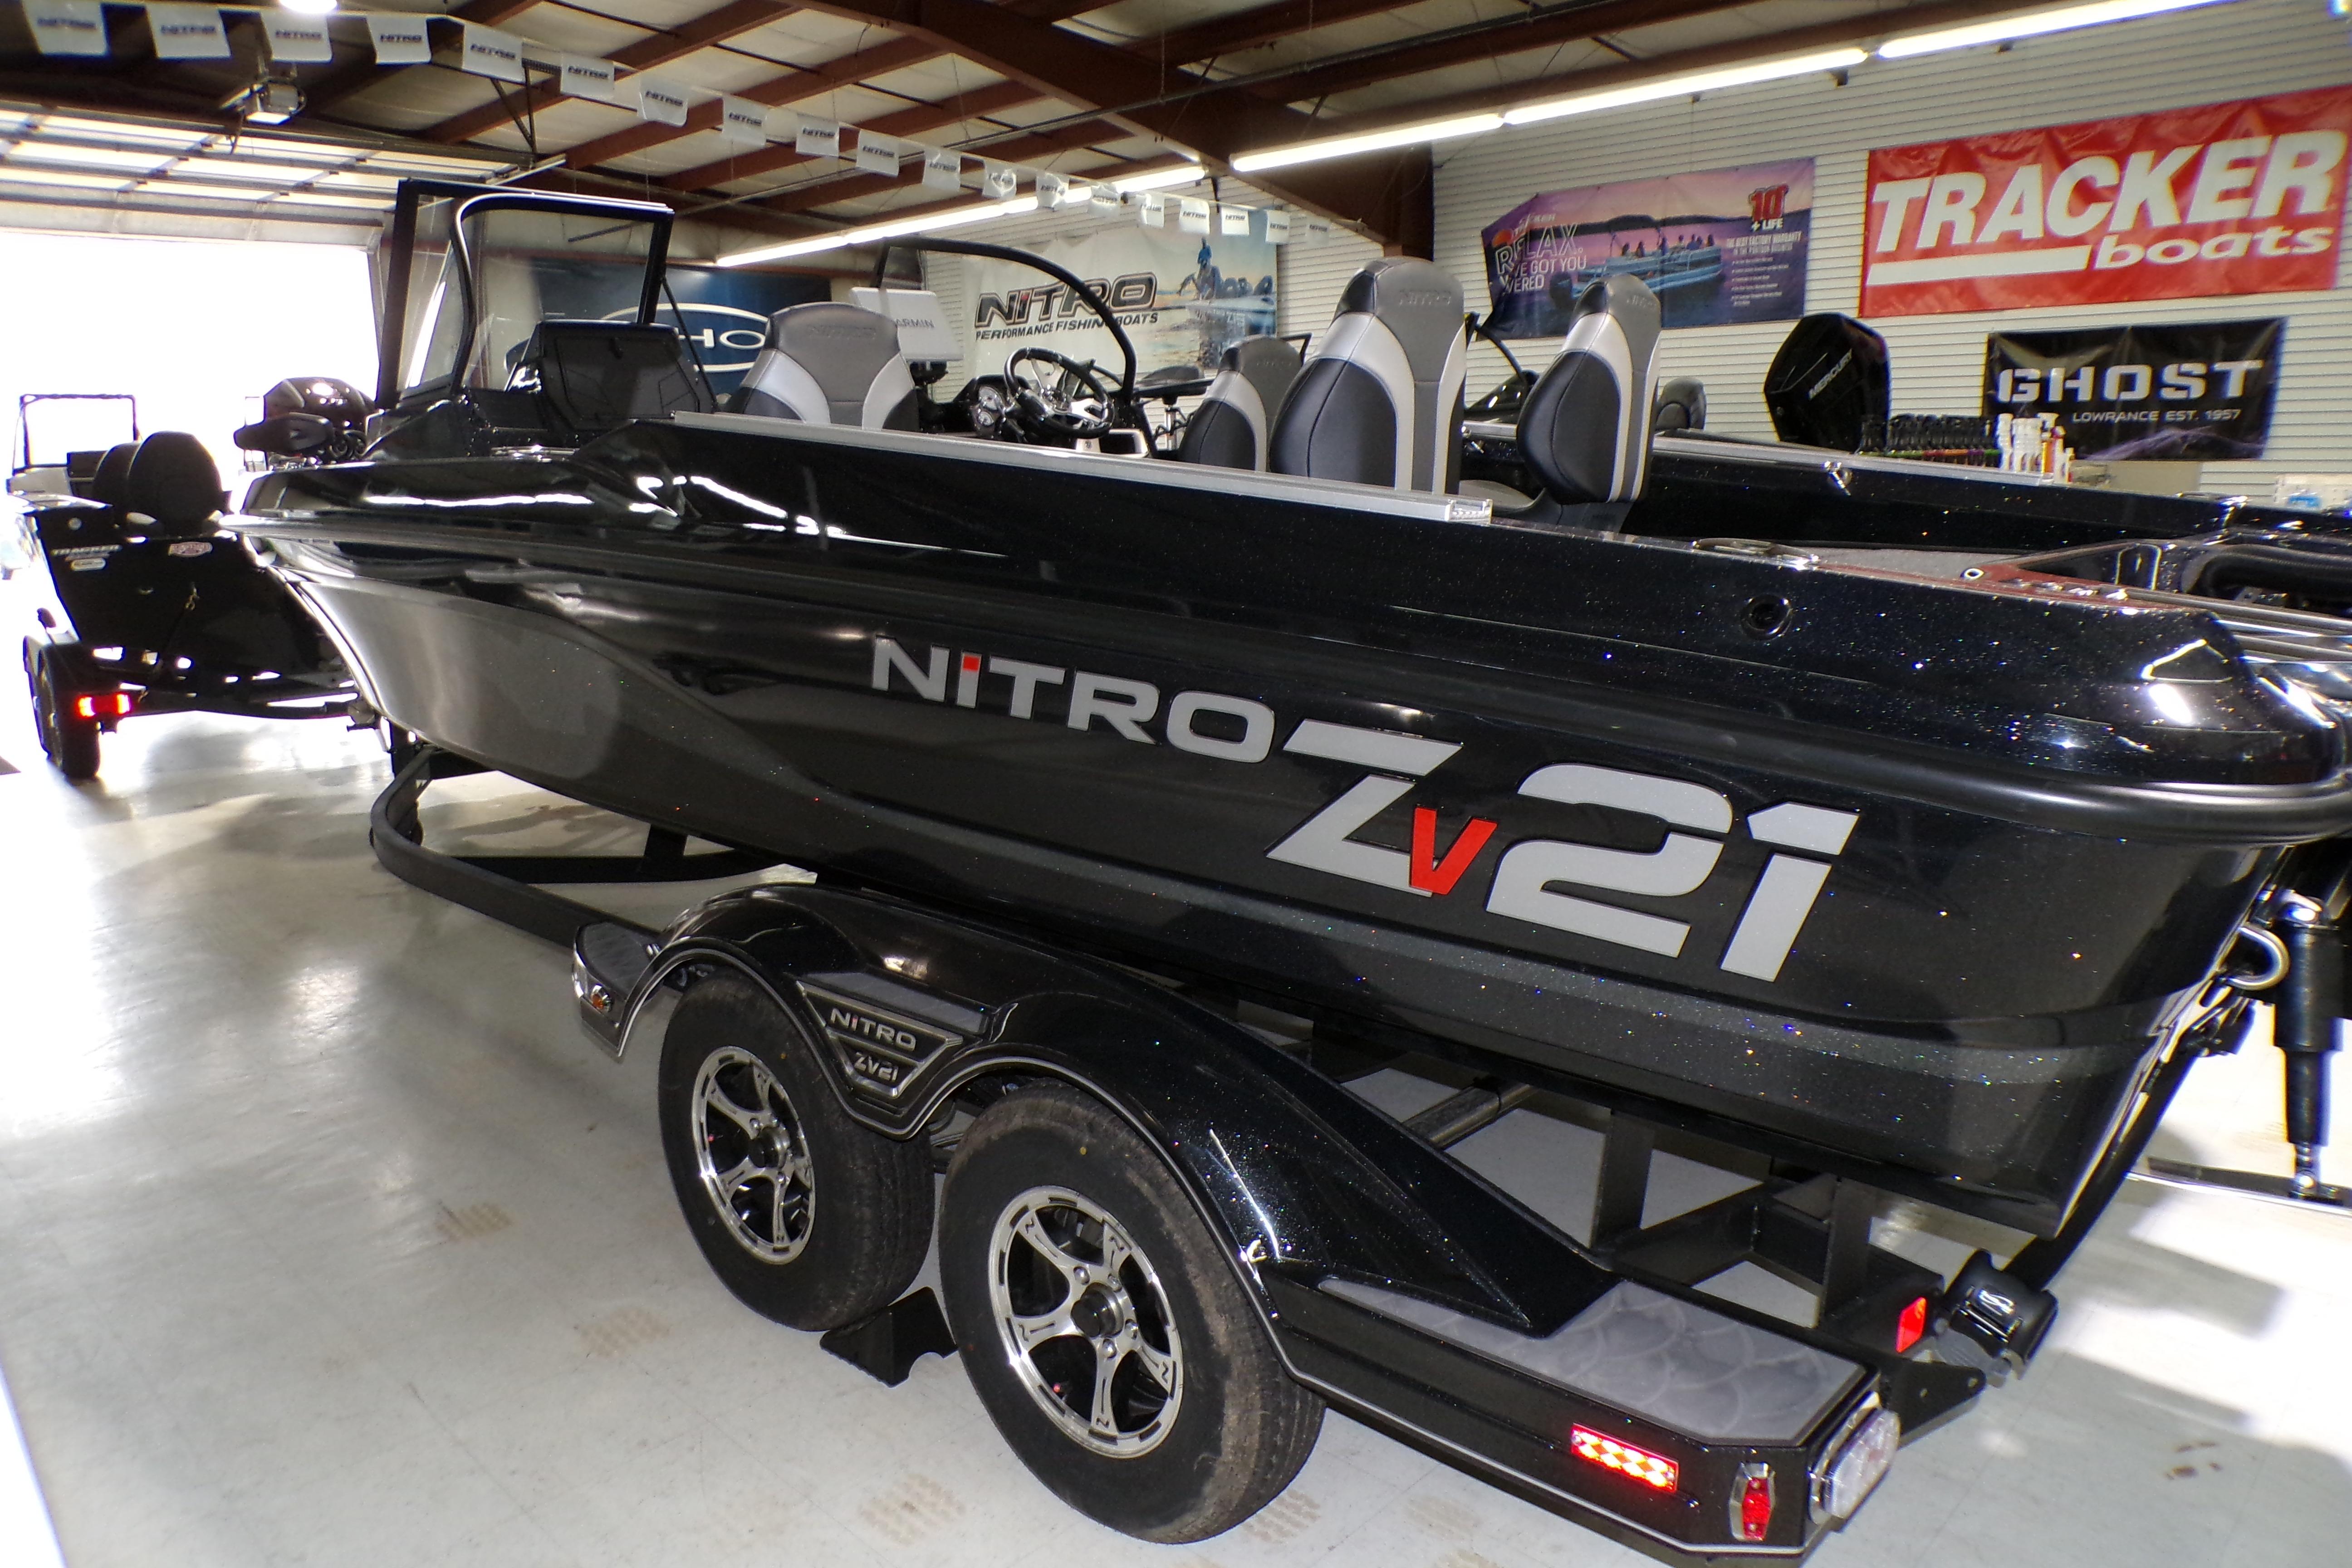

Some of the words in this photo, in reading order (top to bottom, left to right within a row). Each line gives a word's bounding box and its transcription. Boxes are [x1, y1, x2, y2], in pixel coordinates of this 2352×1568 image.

[1749, 185, 1788, 221] 10
[1872, 129, 2348, 253] TRACKER
[1762, 218, 1784, 230] LIFE
[1531, 258, 1557, 274] GOT
[1560, 255, 1587, 273] YOU
[2092, 224, 2335, 271] boats
[975, 271, 1158, 328] NITRO
[896, 318, 935, 328] ARMIN
[975, 323, 1054, 341] PERFORMANCE
[1055, 315, 1110, 331] FISHIN
[1808, 348, 1852, 400] MERCURY
[1997, 358, 2264, 403] GHOST
[2071, 410, 2160, 424] LOWRANCE
[2165, 410, 2199, 422] EST.
[2206, 409, 2241, 421] 1957
